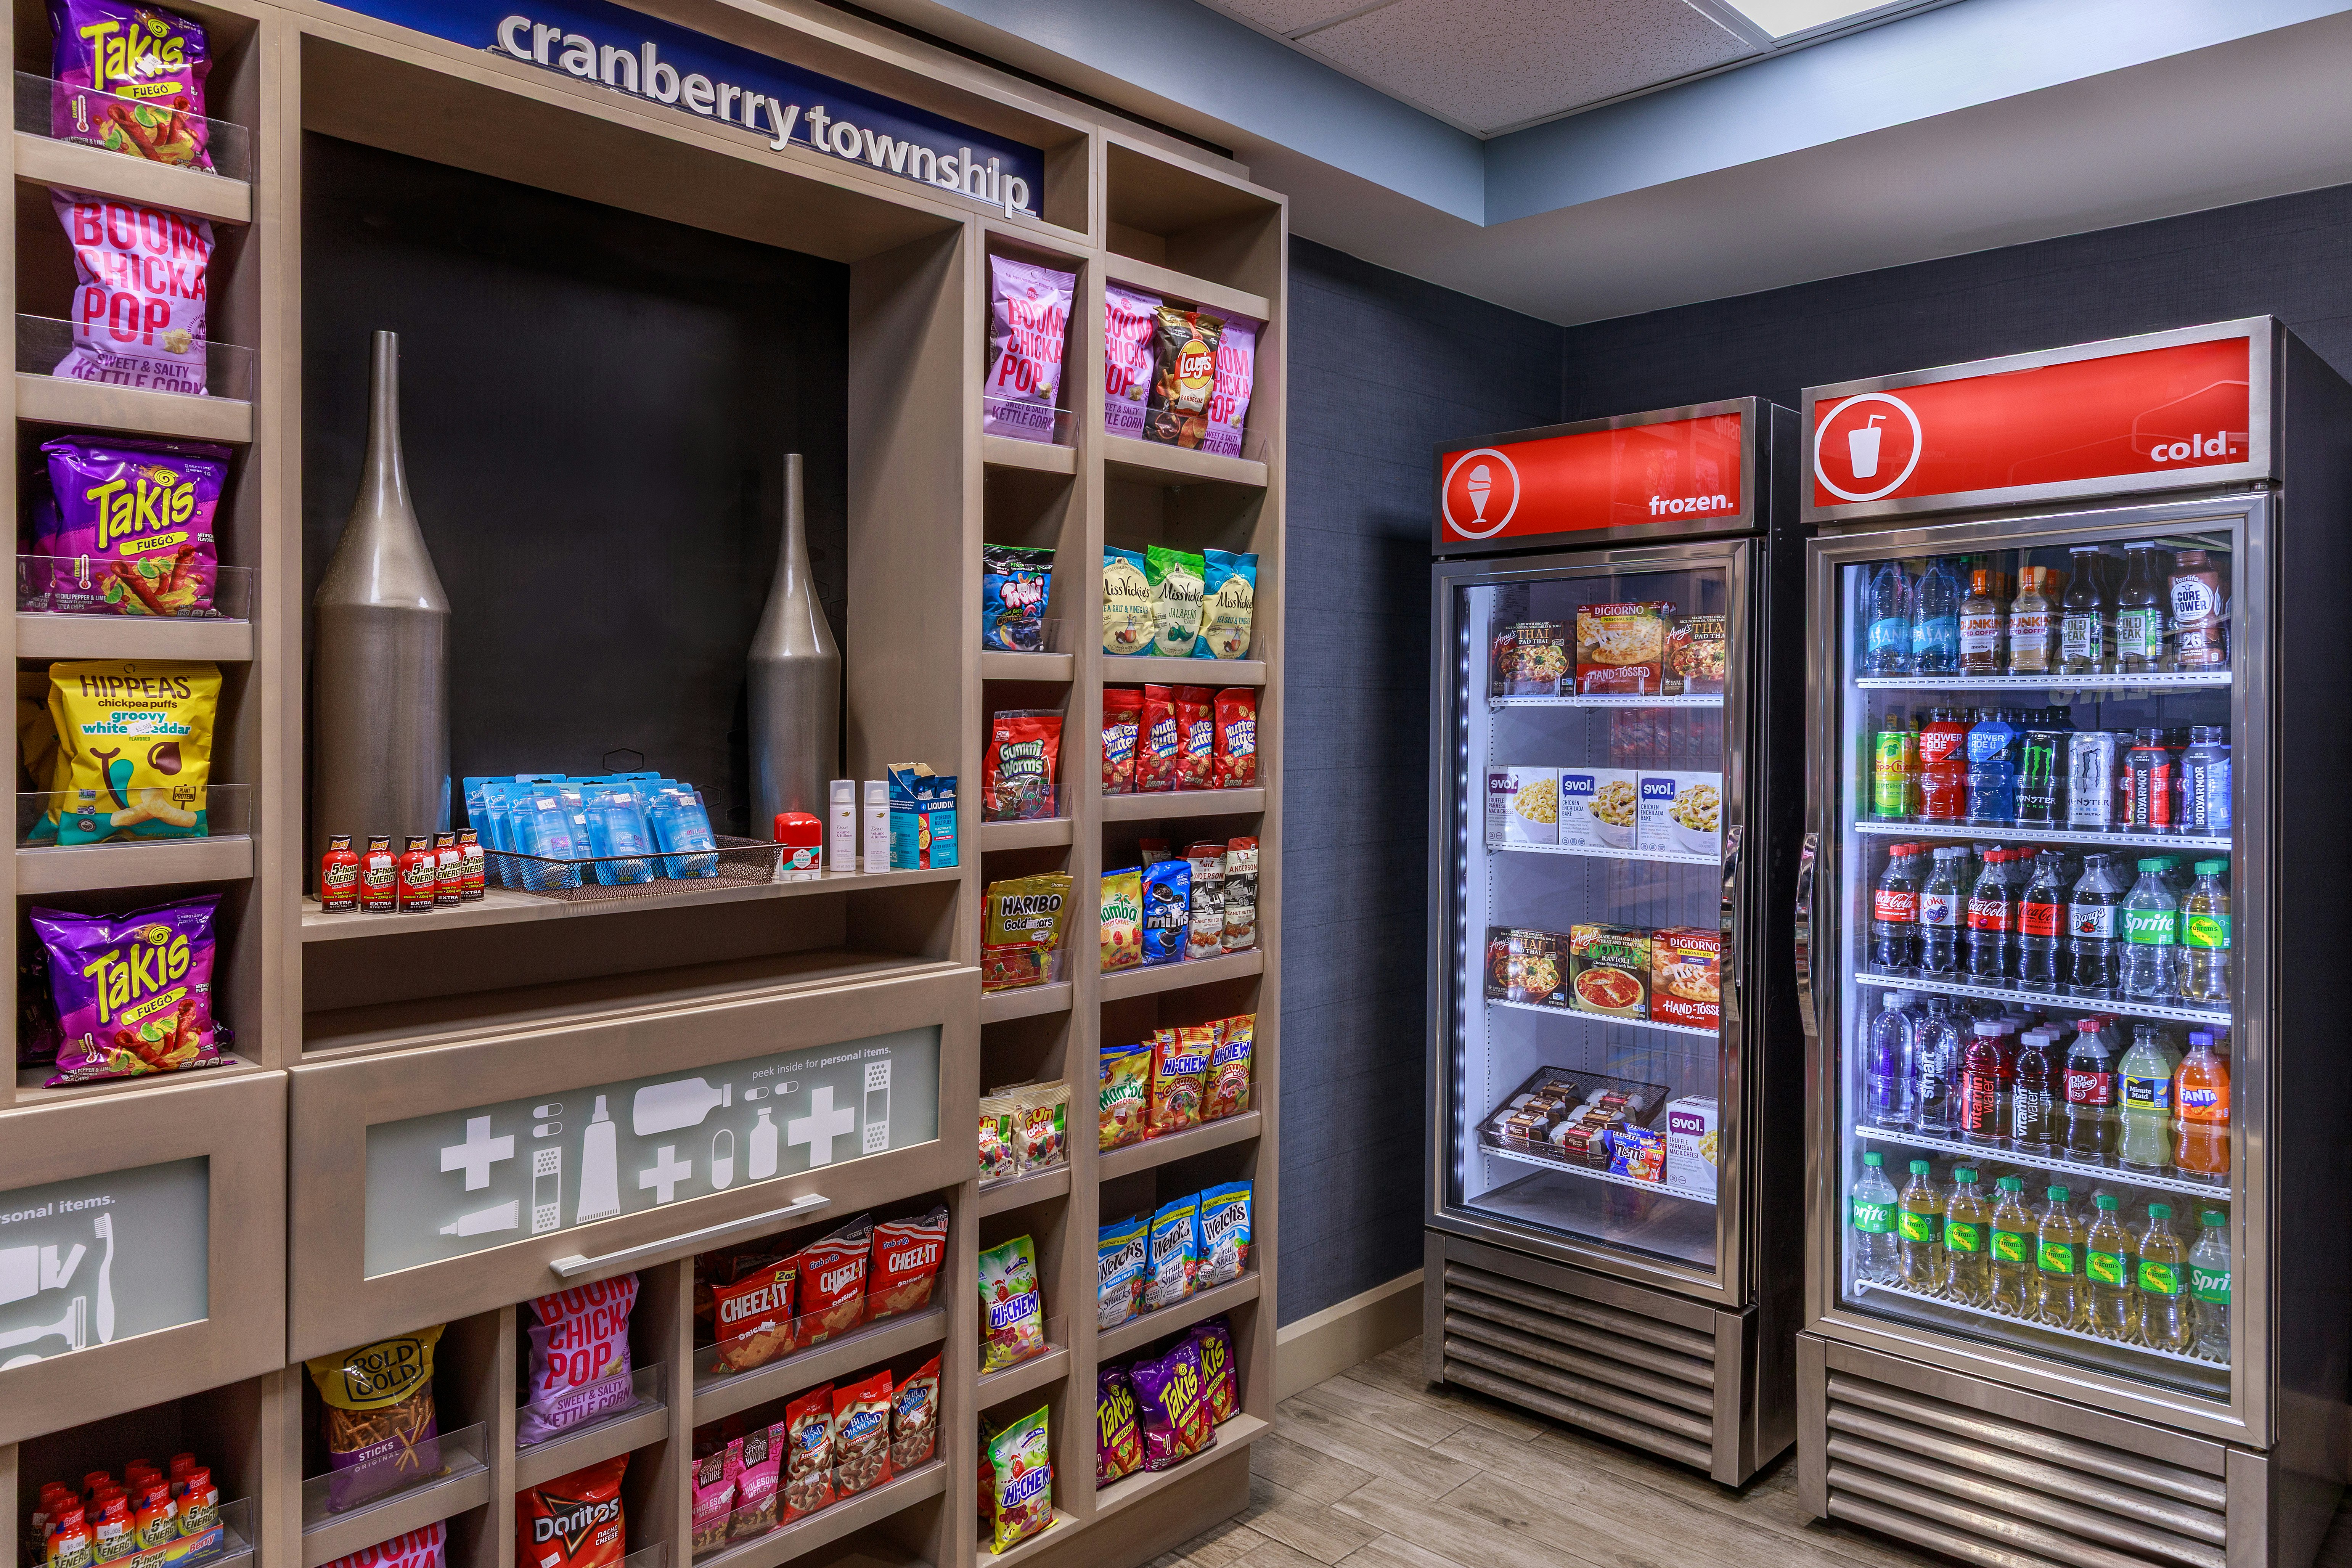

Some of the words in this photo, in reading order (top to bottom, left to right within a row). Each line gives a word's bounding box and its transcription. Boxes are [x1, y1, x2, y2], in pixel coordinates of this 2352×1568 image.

[133, 84, 169, 96] FUEGO
[496, 13, 800, 152] cranberry
[805, 105, 1030, 219] township
[74, 202, 208, 263] BOOM
[78, 249, 206, 301] CHICKA
[83, 288, 170, 346] POP
[1007, 294, 1064, 339] BOOM
[1006, 328, 1063, 365] CHICKA
[96, 353, 138, 371] SWEET
[141, 361, 151, 372] &
[154, 363, 189, 378] SALTY
[998, 354, 1043, 394] POP
[1180, 352, 1211, 379] Lay's
[1181, 395, 1203, 404] BARBECUE
[992, 405, 1028, 425] KETTLE
[2150, 431, 2238, 463] cold.
[87, 470, 194, 548] Takis
[1649, 494, 1733, 515] frozen.
[137, 535, 174, 551] FUEGO
[1002, 577, 1044, 608] Trolli
[1119, 576, 1150, 602] Vickie's
[2177, 590, 2201, 602] CORE
[1112, 605, 1123, 613] SALT
[1129, 605, 1148, 614] VINEGAR
[1169, 608, 1197, 619] JALAPEÑO
[2175, 601, 2207, 612] POWER
[1495, 630, 1516, 646] Amy's
[1517, 629, 1549, 639] THAI
[2064, 631, 2087, 641] PEAK
[2183, 632, 2202, 649] 26
[1587, 666, 1650, 681] HAND-TOSSED
[79, 675, 191, 699] HIPPEAS
[98, 700, 149, 708] chickpea
[150, 700, 177, 708] puffs
[111, 712, 166, 723] groovy
[82, 724, 127, 734] white
[1226, 721, 1255, 738] Nutter
[1927, 733, 1962, 742] POWER
[999, 739, 1044, 761] Gummi
[1160, 747, 1178, 758] BITES
[1228, 733, 1255, 753] Butter
[1926, 741, 1947, 749] ADE
[999, 760, 1043, 777] Worms
[1565, 779, 1593, 792] evol.
[2137, 769, 2147, 824] BODYARMOR
[2195, 766, 2204, 826] BODYARMOR
[329, 871, 358, 885] ENERGY
[332, 863, 357, 875] 5-hour
[1229, 865, 1257, 873] ANDERSON
[1001, 894, 1062, 917] HARIBO
[1876, 890, 1915, 909] Coca-Cola
[1968, 898, 2010, 917] Coca-Cola
[1147, 911, 1189, 929] minis
[2072, 908, 2105, 930] Barq's
[2124, 913, 2174, 933] Sprite
[1588, 943, 1642, 964] BOWLS
[1602, 955, 1630, 964] RAVIOLI
[84, 927, 190, 1023] Takis
[138, 994, 173, 1017] FUEGO
[1212, 1039, 1251, 1067] HI-CHEW
[752, 1069, 774, 1081] peek
[778, 1062, 803, 1074] inside
[805, 1060, 818, 1069] for
[821, 1050, 861, 1068] personal
[864, 1047, 891, 1058] items.
[1161, 1055, 1210, 1076] HI-CHEW
[1923, 1051, 1934, 1099] smart
[2071, 1078, 2095, 1089] Pepper
[1163, 1076, 1202, 1096] Getaway
[1983, 1078, 1994, 1113] water
[2129, 1086, 2151, 1094] Minute
[2180, 1089, 2217, 1102] FANTA
[1972, 1077, 1982, 1129] vitamin
[2018, 1087, 2028, 1137] vitamin
[2027, 1091, 2038, 1122] water
[1671, 1117, 1703, 1132] evol.
[1669, 1136, 1688, 1145] TRUFFLE
[1669, 1142, 1693, 1152] PARMESAN
[1048, 1151, 1057, 1160] mixed
[59, 1195, 116, 1213] items.
[1205, 1205, 1246, 1240] Welch's
[1948, 1227, 1976, 1238] Seagram's
[883, 1239, 895, 1250] Grab
[888, 1243, 938, 1273] CHEEZ-IT
[2089, 1257, 2119, 1269] Seagram's
[1108, 1277, 1121, 1286] MIXED
[1121, 1271, 1133, 1280] FRUIT
[721, 1282, 788, 1323] CHEEZ-IT
[353, 1345, 413, 1373] ROLD
[544, 1342, 611, 1390] POP
[356, 1364, 417, 1396] GOLD
[557, 1391, 586, 1410] SWEET
[598, 1380, 623, 1397] SALTY
[542, 1405, 594, 1428] KETTLE
[599, 1386, 631, 1410] CORN
[842, 1412, 882, 1439] DIAMOND
[850, 1414, 871, 1427] BLUE
[847, 1428, 882, 1447] Smokehouse
[359, 1442, 394, 1462] STICKS
[745, 1440, 767, 1458] SECOND
[745, 1449, 767, 1467] NATURE
[355, 1451, 399, 1472] ORIGINAL
[190, 1475, 208, 1488] Berry
[748, 1484, 771, 1499] MEDLEY
[535, 1497, 620, 1544] Doritos
[189, 1534, 215, 1553] Berry
[596, 1531, 619, 1546] CHEESE
